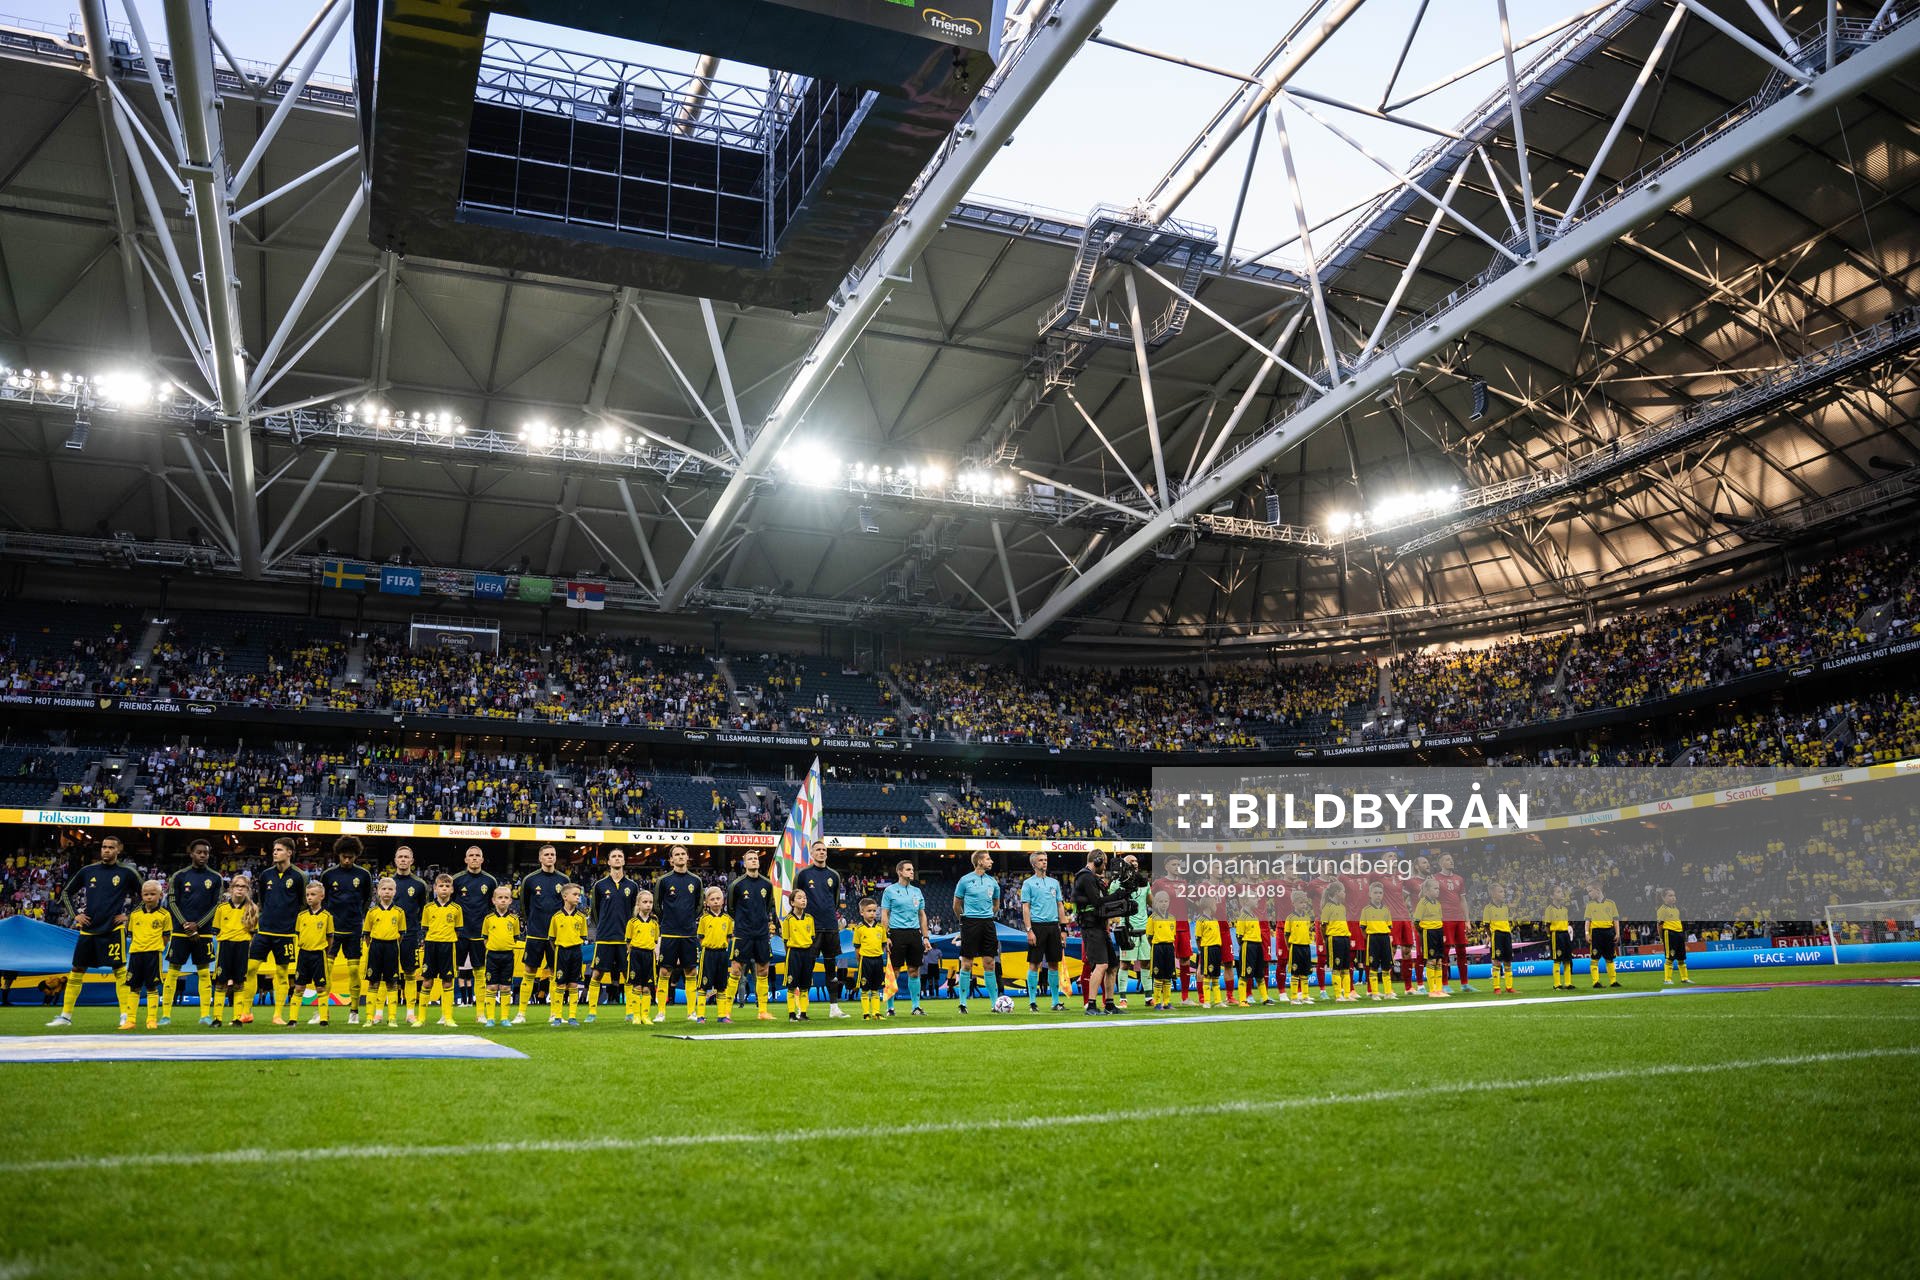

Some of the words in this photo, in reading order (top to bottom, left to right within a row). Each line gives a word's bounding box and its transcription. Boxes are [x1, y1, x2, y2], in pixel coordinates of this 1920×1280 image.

[931, 16, 973, 36] friends
[386, 575, 416, 587] FIFA
[476, 581, 503, 593] UEFA
[441, 636, 469, 645] friends
[1872, 647, 1888, 659] MOT
[1889, 641, 1920, 655] MOBBNI
[35, 697, 52, 705] MOT
[54, 699, 95, 708] MOBBNING
[119, 701, 152, 711] FRIENDS
[153, 703, 180, 712] ARENA
[716, 734, 761, 743] TILLSAMMANS
[761, 736, 775, 744] MOT
[775, 737, 808, 745] MOBBNING
[823, 739, 849, 747] FRIENDS
[1424, 738, 1451, 747] FRIENDS
[1451, 736, 1473, 744] ARENA
[1323, 746, 1364, 757] TILLSAMMANS
[1364, 745, 1377, 753] MOT
[1378, 742, 1409, 751] MOBBNING
[1725, 786, 1768, 801] Scandic
[1657, 802, 1673, 812] ICA
[38, 811, 91, 825] Folksam
[160, 815, 181, 827] ICA
[1580, 813, 1613, 825] Folksam
[253, 819, 305, 832] Scandic
[448, 828, 489, 837] Swedbank
[632, 834, 690, 842] VOLVO
[1414, 831, 1460, 842] BAUHAUS
[726, 834, 774, 845] BAUHAUS
[899, 838, 937, 849] Folksam
[985, 840, 1001, 849] ICA
[1331, 837, 1382, 846] VOLVO
[1051, 841, 1087, 851] Scandic
[108, 943, 121, 957] 22
[283, 943, 295, 957] 19
[1753, 952, 1786, 963] PEACE
[1614, 960, 1634, 970] EACE
